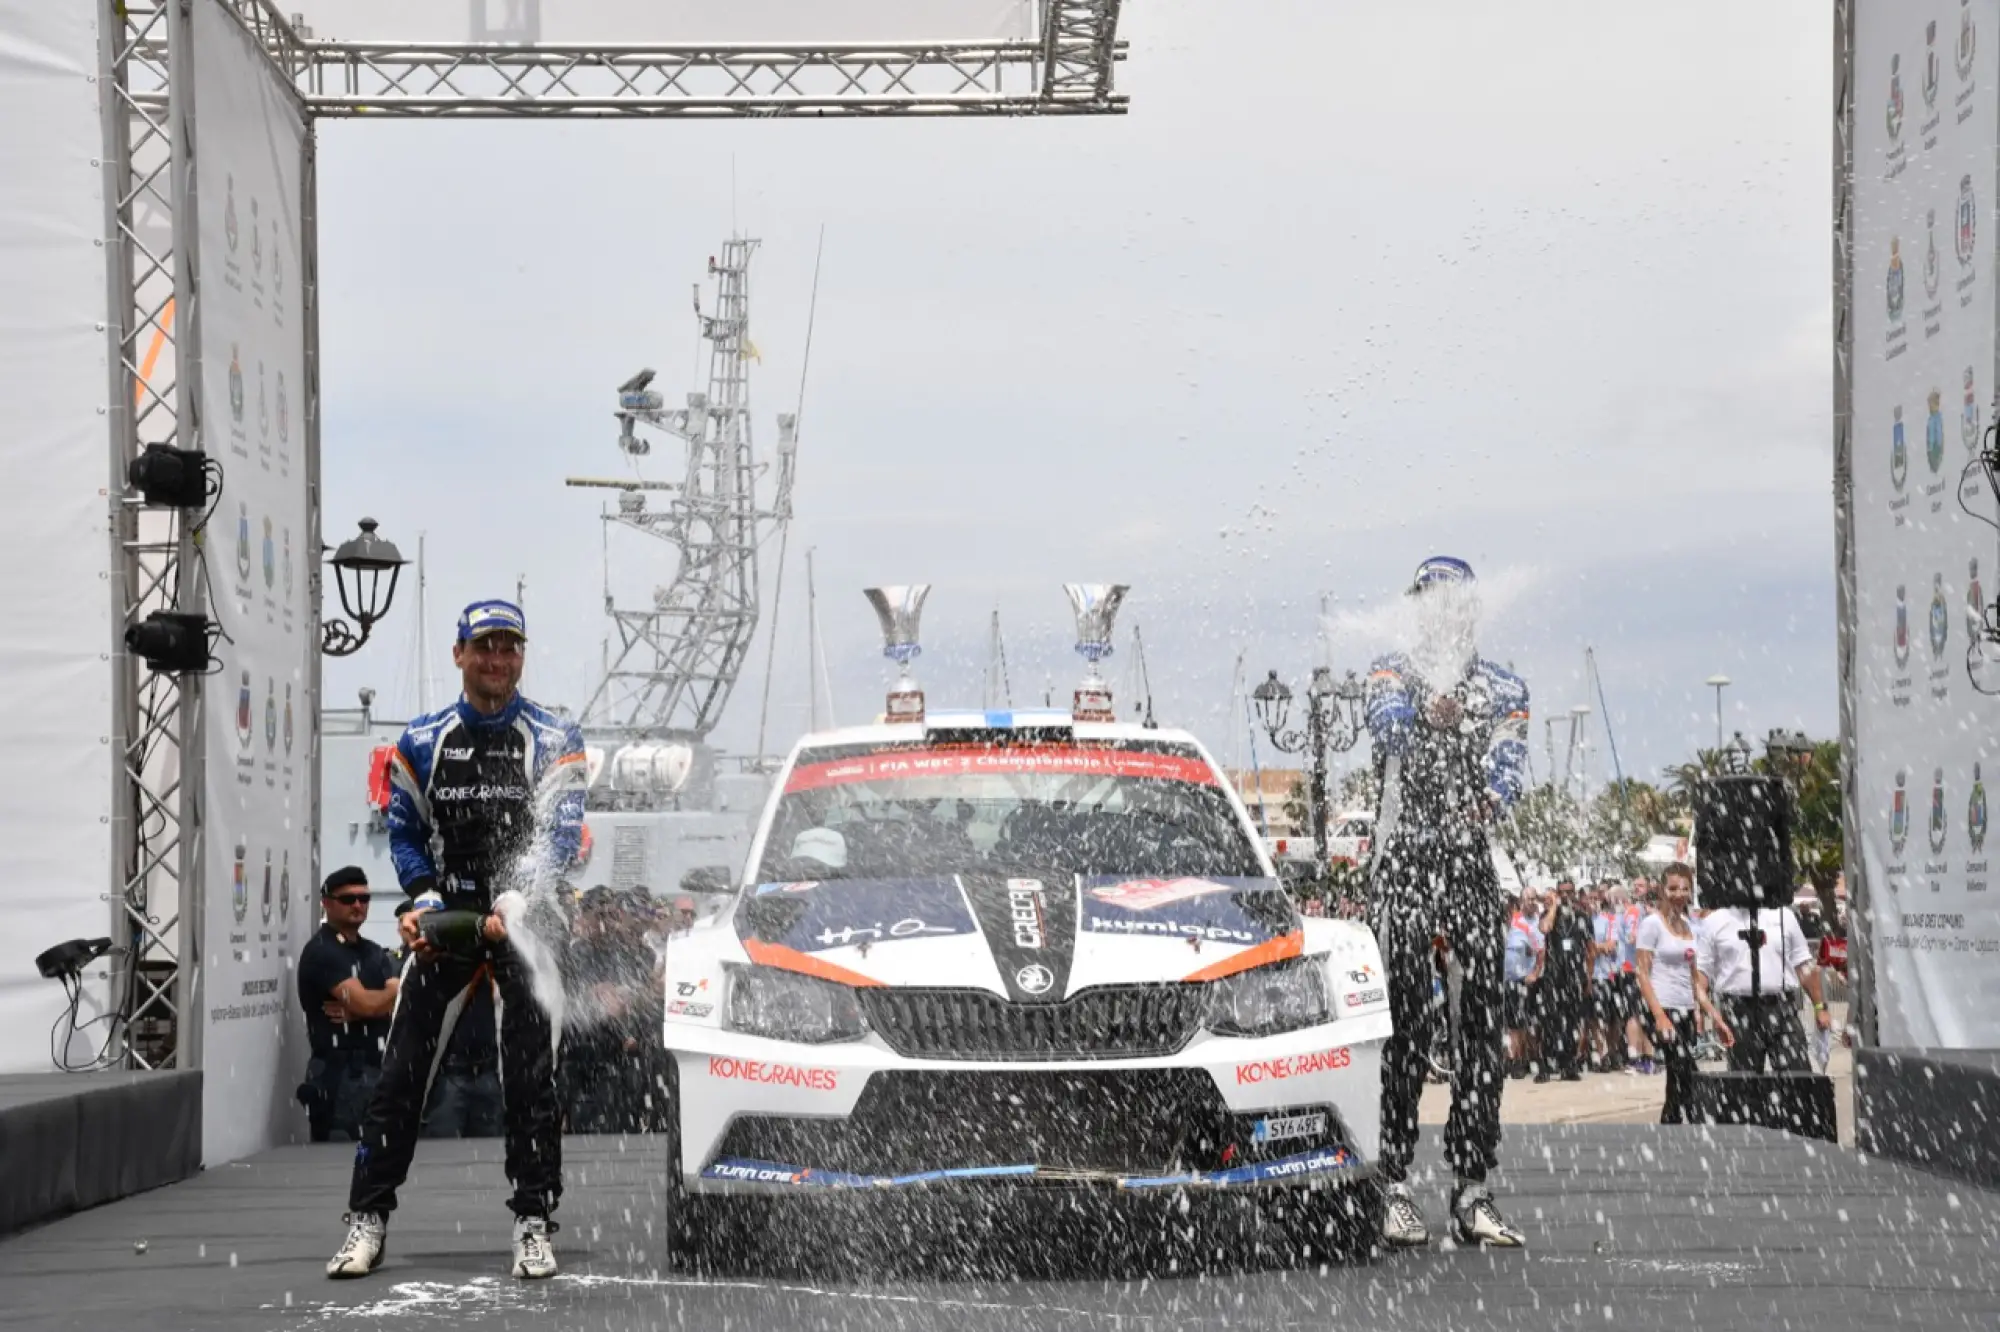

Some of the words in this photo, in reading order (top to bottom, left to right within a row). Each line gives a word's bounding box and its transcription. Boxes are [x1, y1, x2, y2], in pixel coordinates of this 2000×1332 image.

[879, 761, 909, 773] FIA
[435, 785, 525, 801] KONECRANES
[708, 1055, 837, 1090] KONECRANES
[1236, 1046, 1351, 1085] KONECRANES
[713, 1164, 757, 1178] TURN
[758, 1170, 793, 1182] ONE
[1265, 1160, 1306, 1177] TURN
